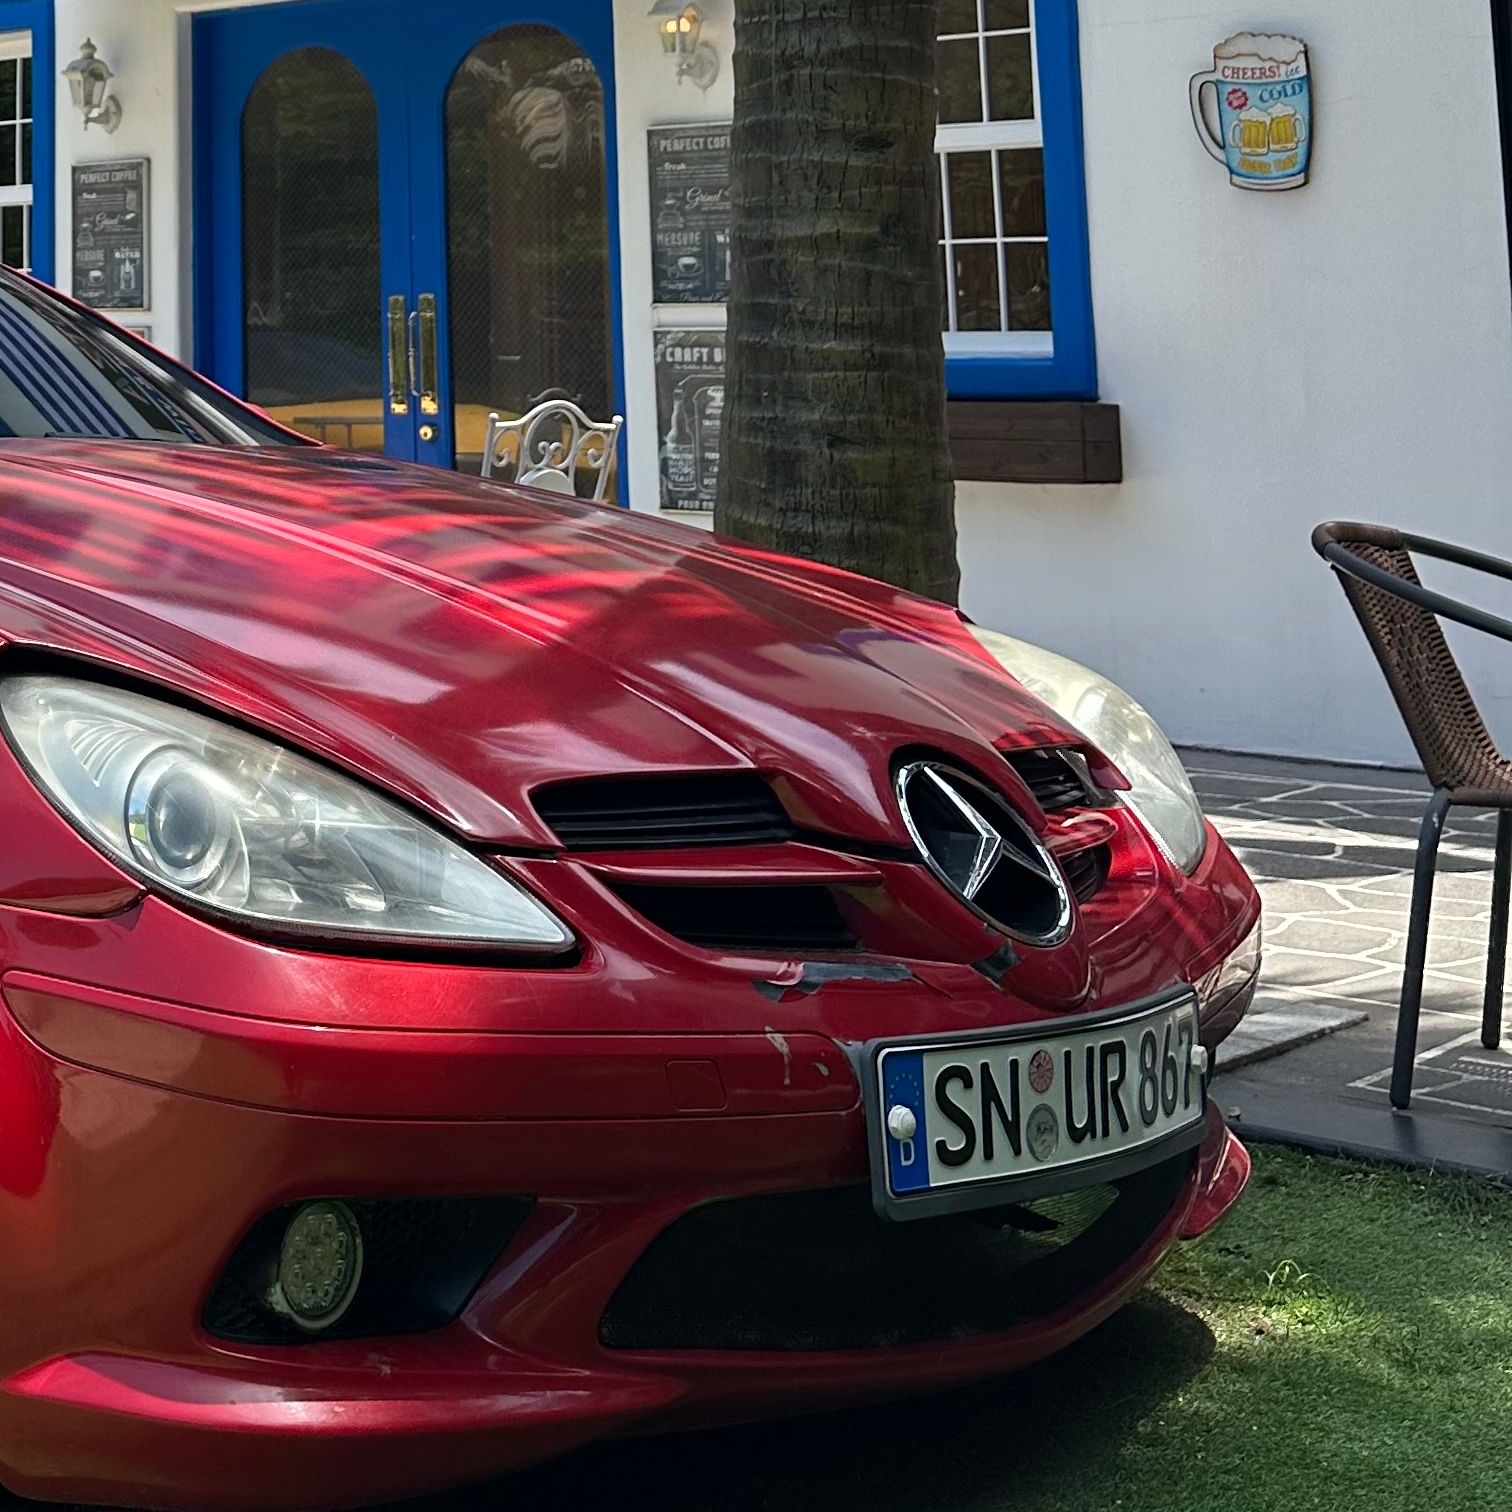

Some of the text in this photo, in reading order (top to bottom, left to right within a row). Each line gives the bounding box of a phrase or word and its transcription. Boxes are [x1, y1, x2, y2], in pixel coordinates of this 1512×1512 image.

[1222, 64, 1282, 80] CHEERS!
[1259, 80, 1304, 103] COLD
[660, 138, 704, 152] PERFECT
[666, 347, 710, 363] CRAFT
[934, 1017, 1195, 1167] SN UR 867
[899, 1137, 916, 1167] D
